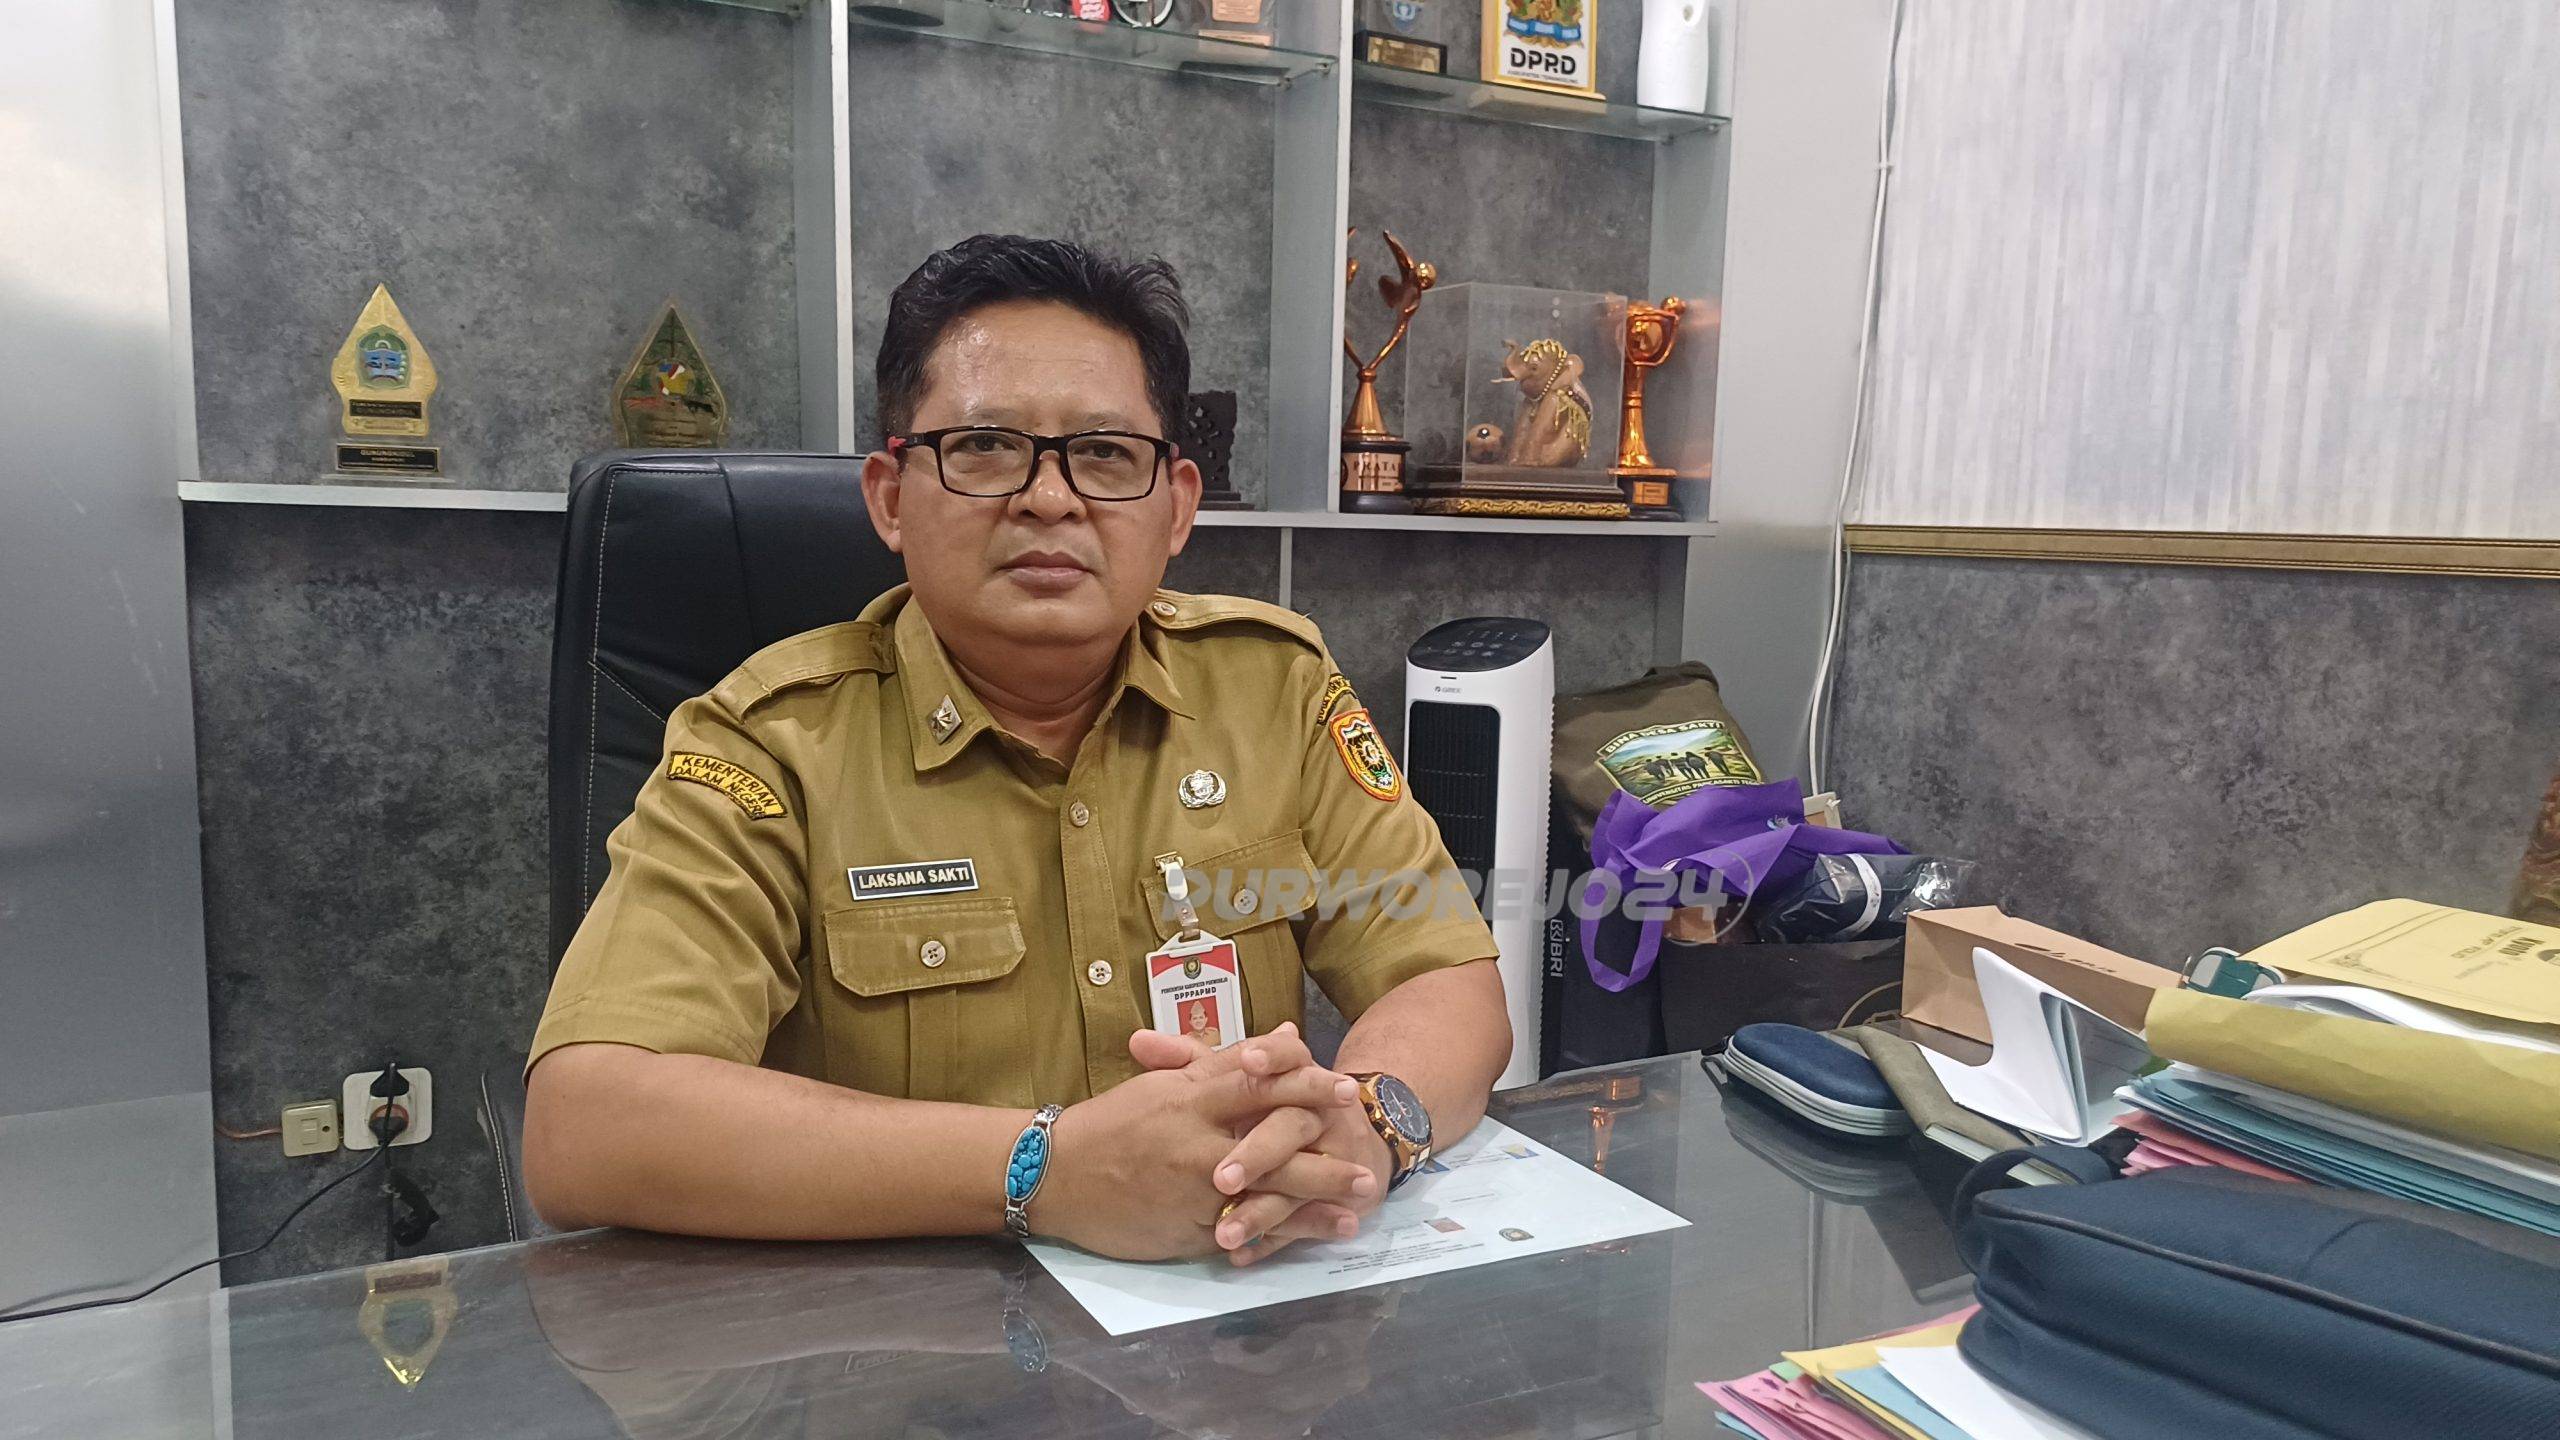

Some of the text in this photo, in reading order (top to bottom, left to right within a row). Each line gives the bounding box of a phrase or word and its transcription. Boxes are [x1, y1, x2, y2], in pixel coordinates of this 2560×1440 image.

[1511, 47, 1576, 75] DPRD
[1605, 732, 1639, 753] BINA
[1678, 721, 1721, 731] SAKTI
[674, 766, 726, 786] DALAM
[682, 756, 778, 807] KEMENTERIAN
[858, 866, 970, 889] LAKSANA SAKTI
[1174, 986, 1217, 1000] DPPPAPMD
